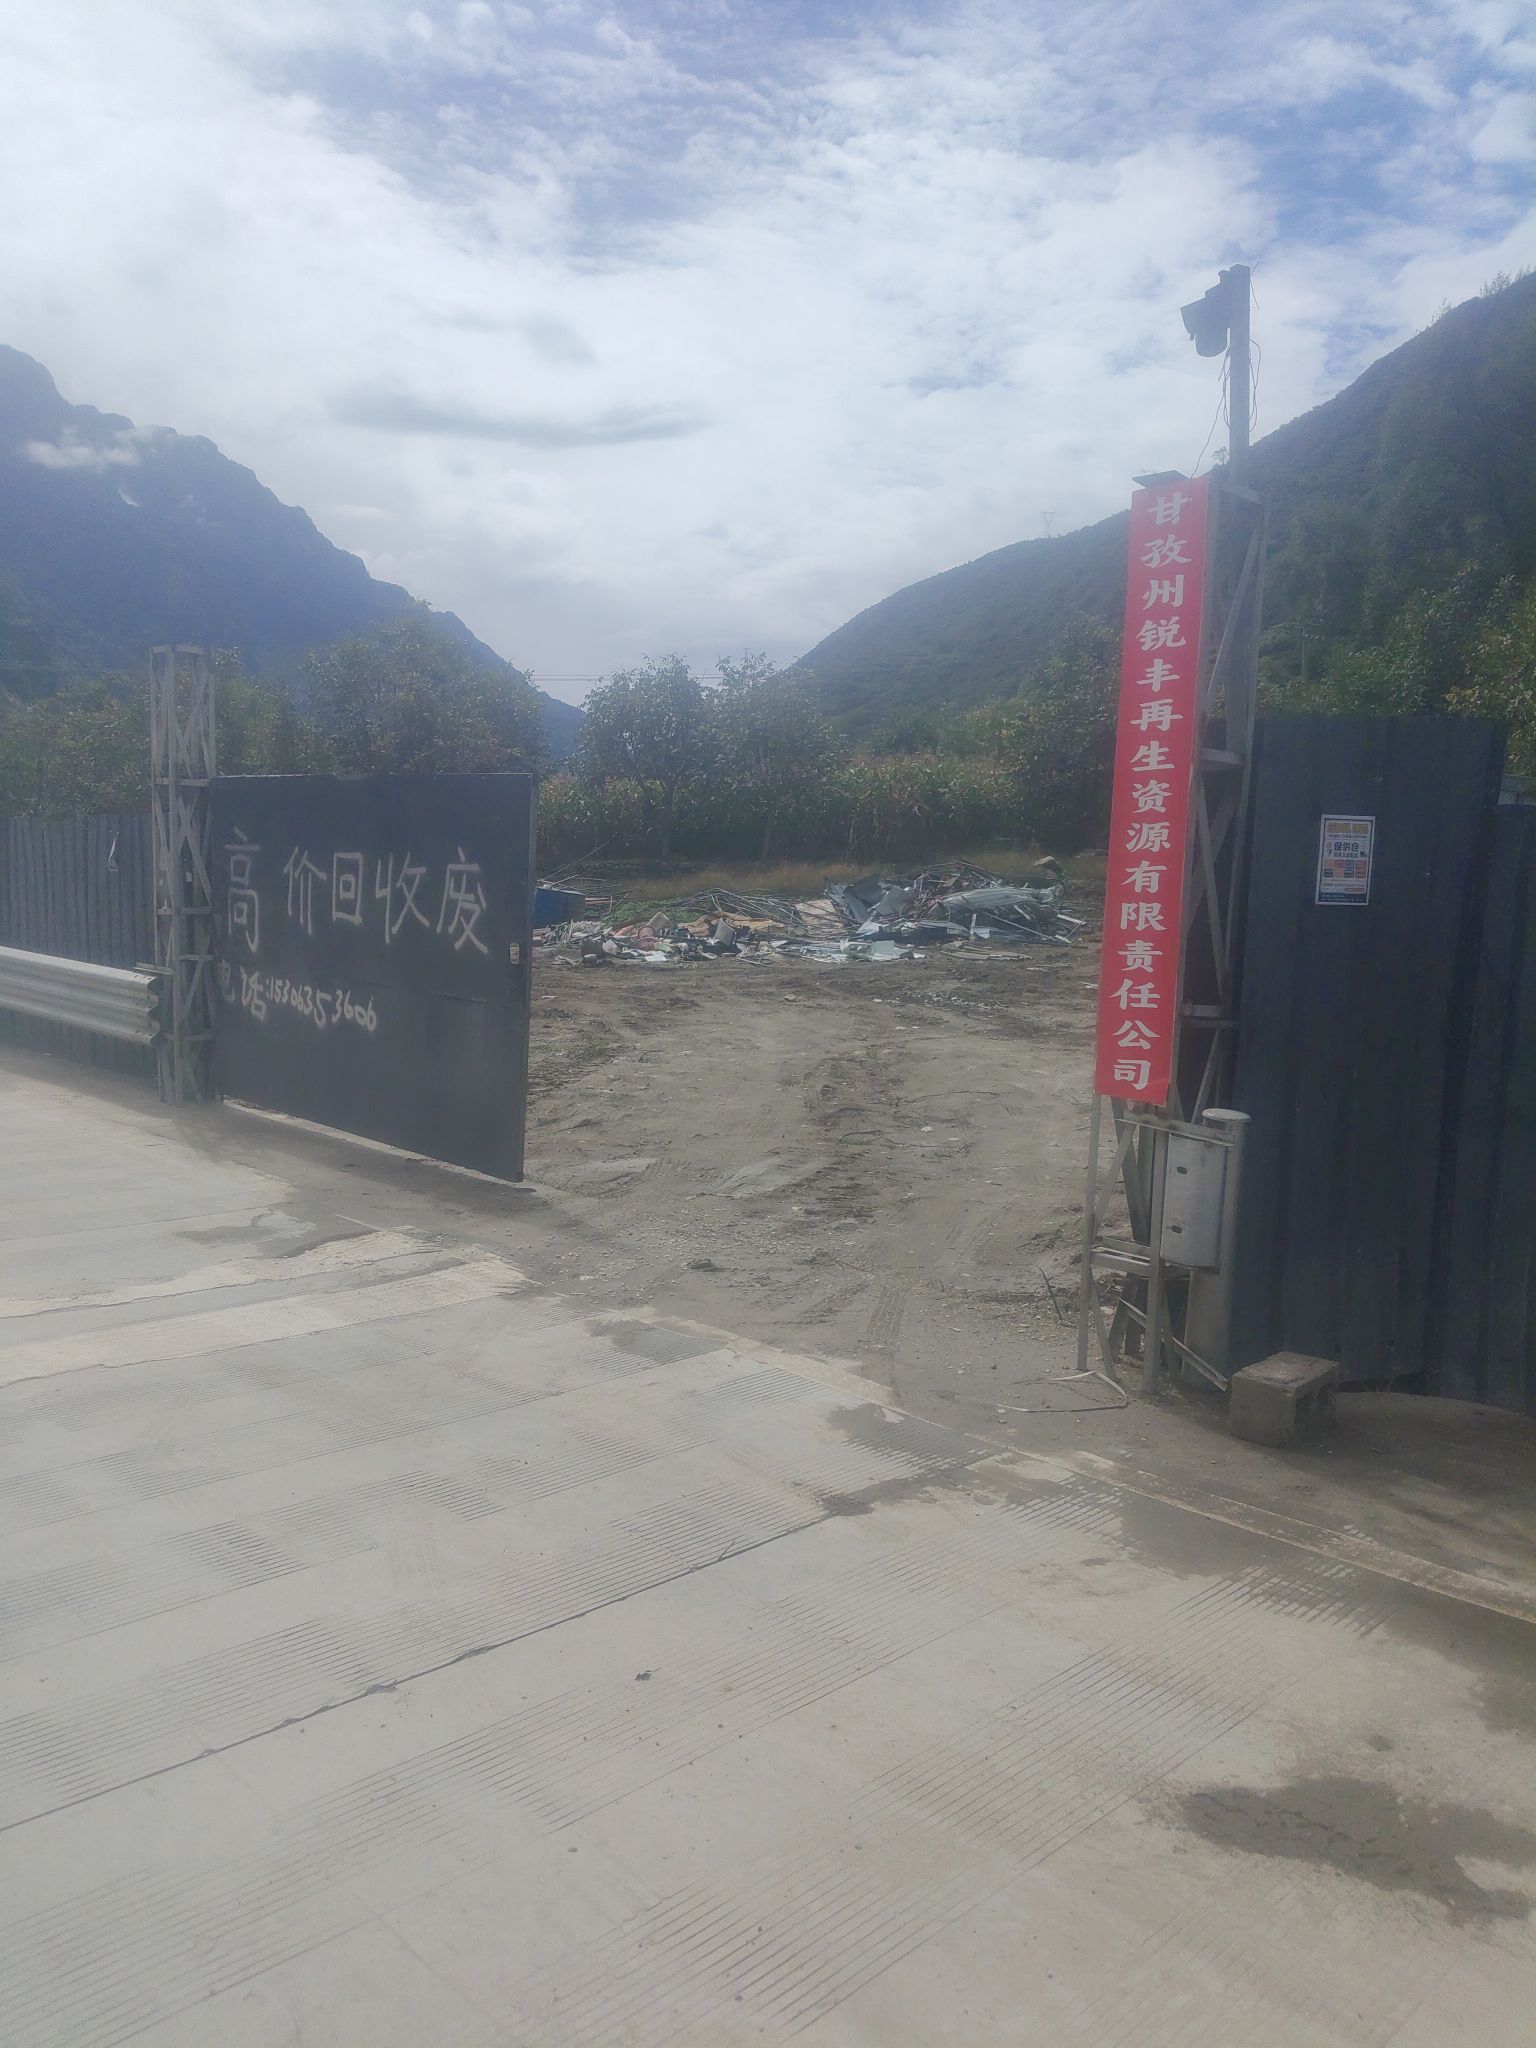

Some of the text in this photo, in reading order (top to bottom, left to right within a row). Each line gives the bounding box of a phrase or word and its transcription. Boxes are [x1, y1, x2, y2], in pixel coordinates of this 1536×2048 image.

[225, 826, 488, 952] 高价回收废
[1111, 493, 1192, 1090] 甘孜州锐丰再生资源有限责任公司
